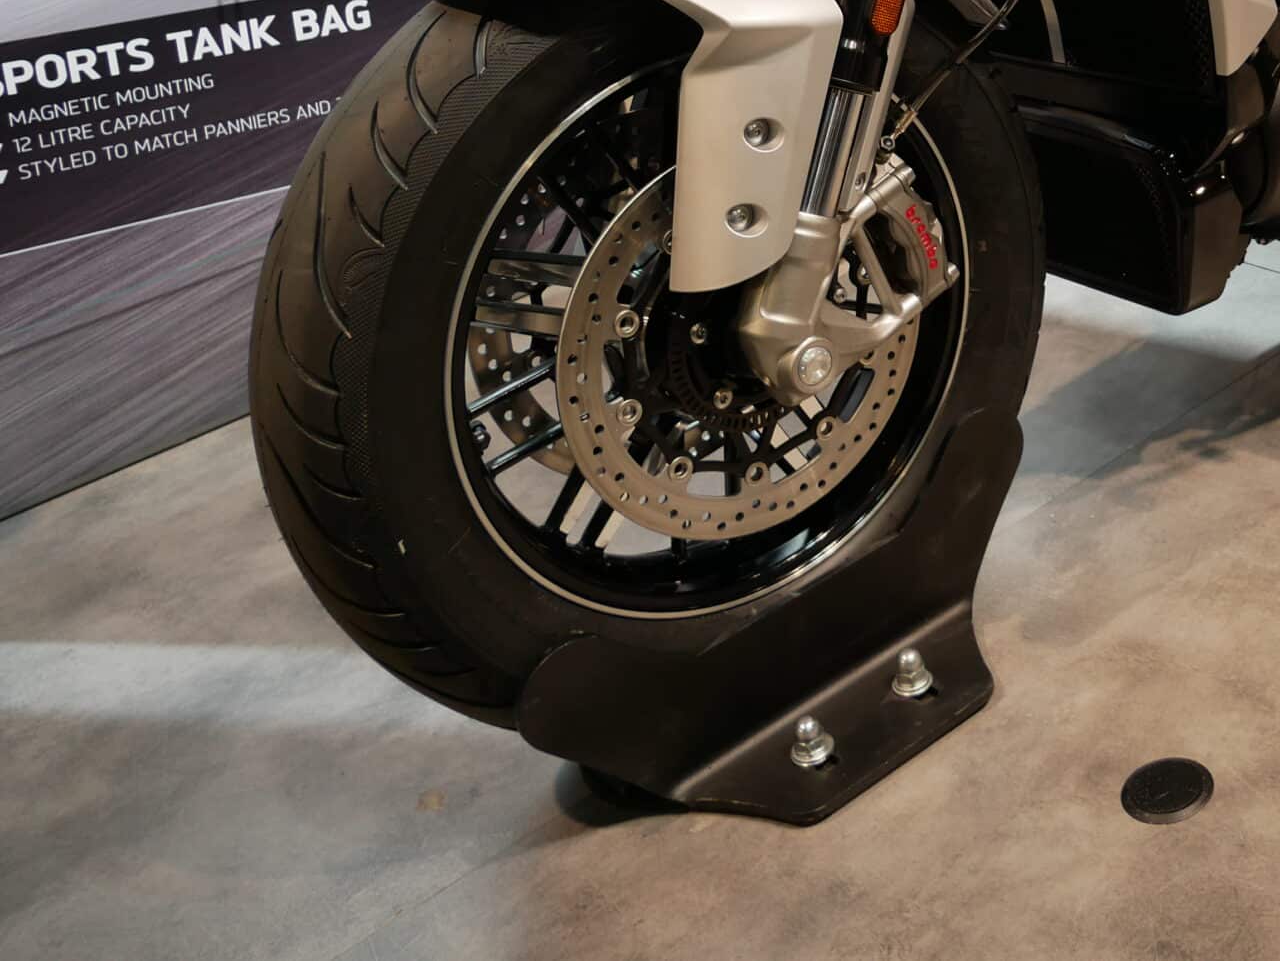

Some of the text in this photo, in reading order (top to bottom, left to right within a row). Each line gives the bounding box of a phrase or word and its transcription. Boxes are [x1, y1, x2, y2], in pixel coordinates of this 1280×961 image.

[0, 0, 372, 97] PORTS TANK BAG
[8, 73, 214, 128] MAGNETIC MOUNTING
[12, 103, 191, 154] 12 LITRE CAPACITY
[18, 100, 331, 180] STYLED TO MATCH PANNIERS AND
[905, 203, 939, 270] brembo
